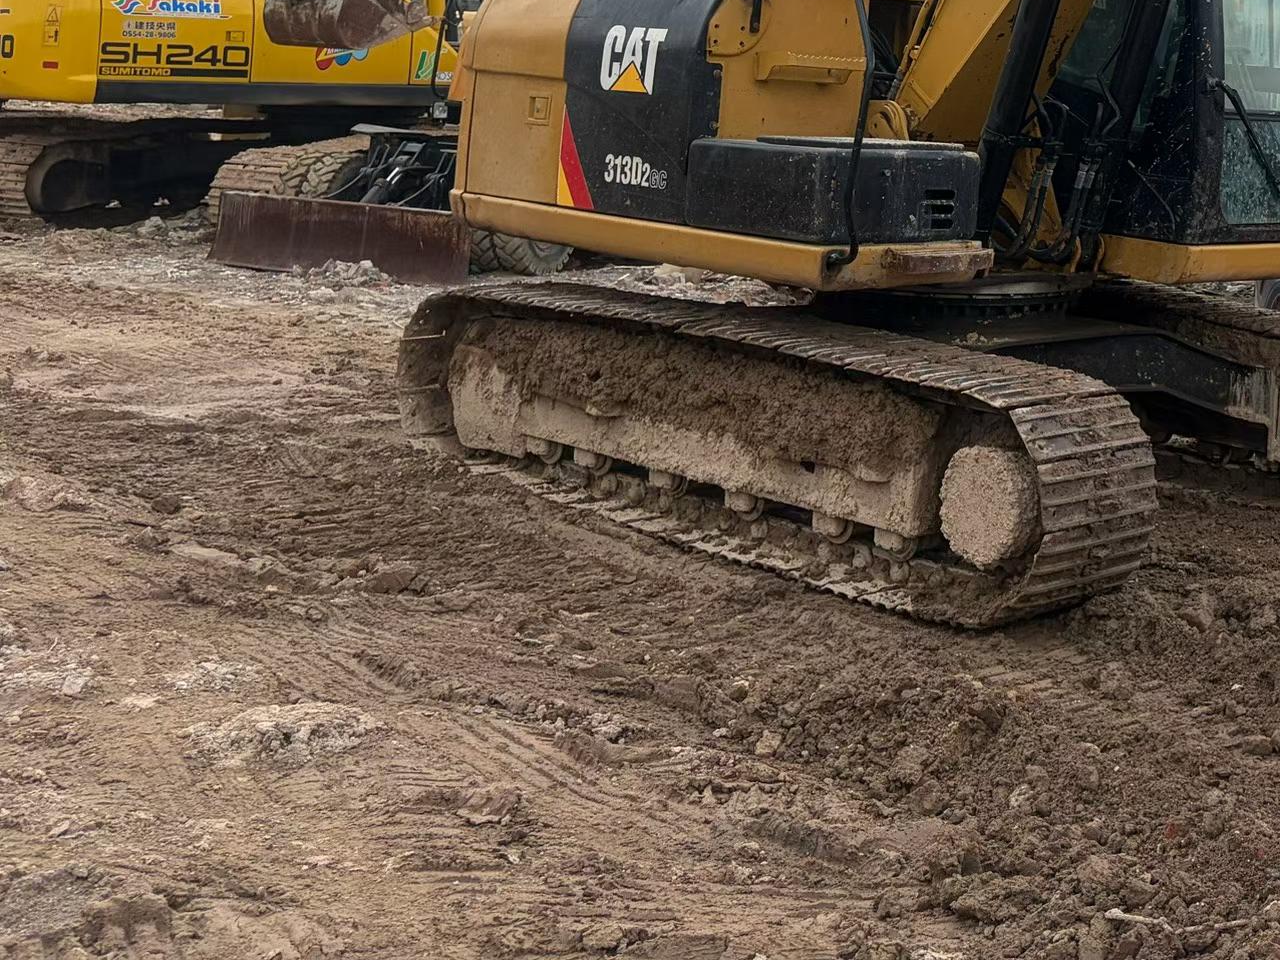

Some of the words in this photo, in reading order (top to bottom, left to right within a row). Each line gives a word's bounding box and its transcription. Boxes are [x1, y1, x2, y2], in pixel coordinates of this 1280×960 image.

[100, 42, 250, 67] SH240
[600, 24, 669, 95] CAT
[101, 66, 171, 77] SUMITOMO
